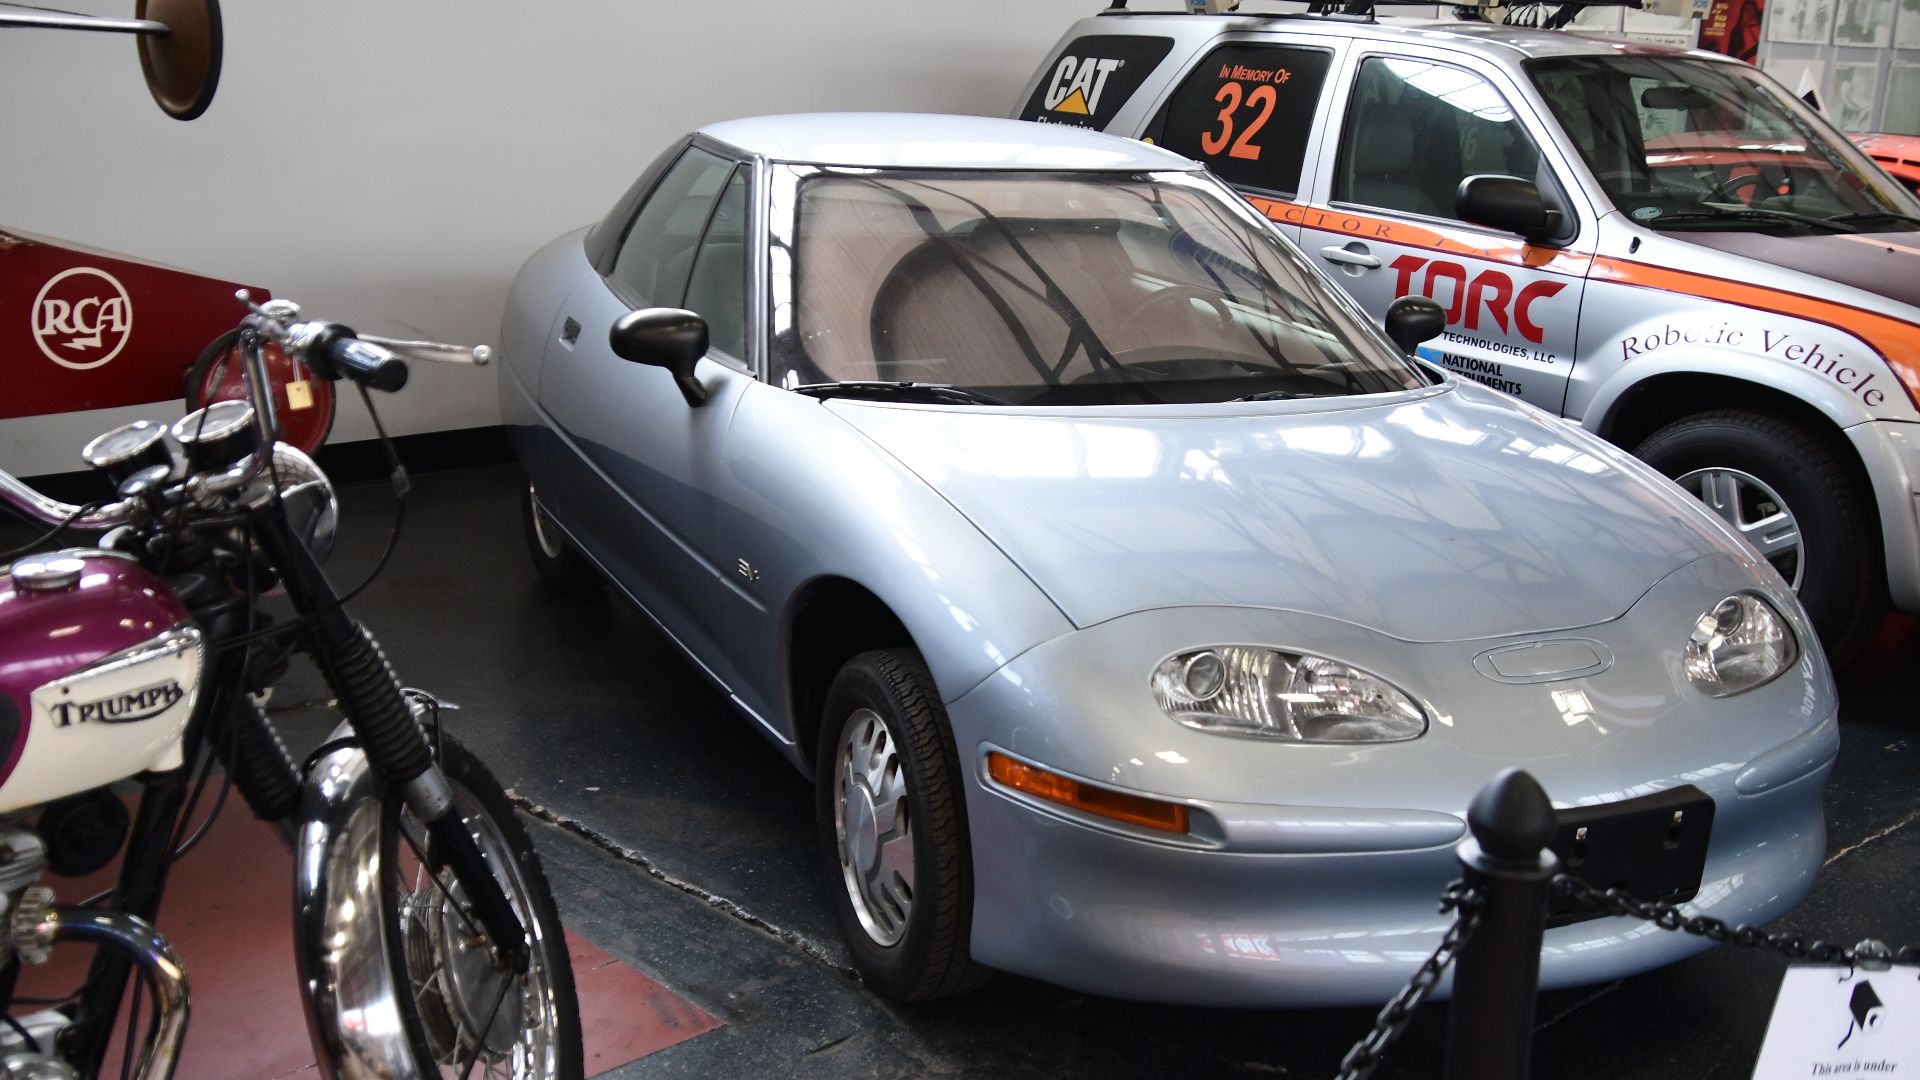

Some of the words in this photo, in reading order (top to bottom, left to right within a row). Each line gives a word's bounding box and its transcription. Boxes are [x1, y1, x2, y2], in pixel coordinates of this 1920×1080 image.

[1044, 56, 1119, 115] CAT
[1201, 81, 1277, 160] 32
[1263, 204, 1391, 238] ICTOR
[40, 296, 127, 342] RCA
[1388, 254, 1568, 344] TORC
[1442, 331, 1529, 361] TECHNOLOGIES,
[1533, 351, 1556, 364] LLC
[1443, 353, 1503, 377] NATIONAL
[1762, 329, 1885, 407] Vehicle
[51, 681, 183, 727] TRIUMPH
[1811, 1062, 1832, 1076] This
[1863, 1059, 1897, 1073] under
